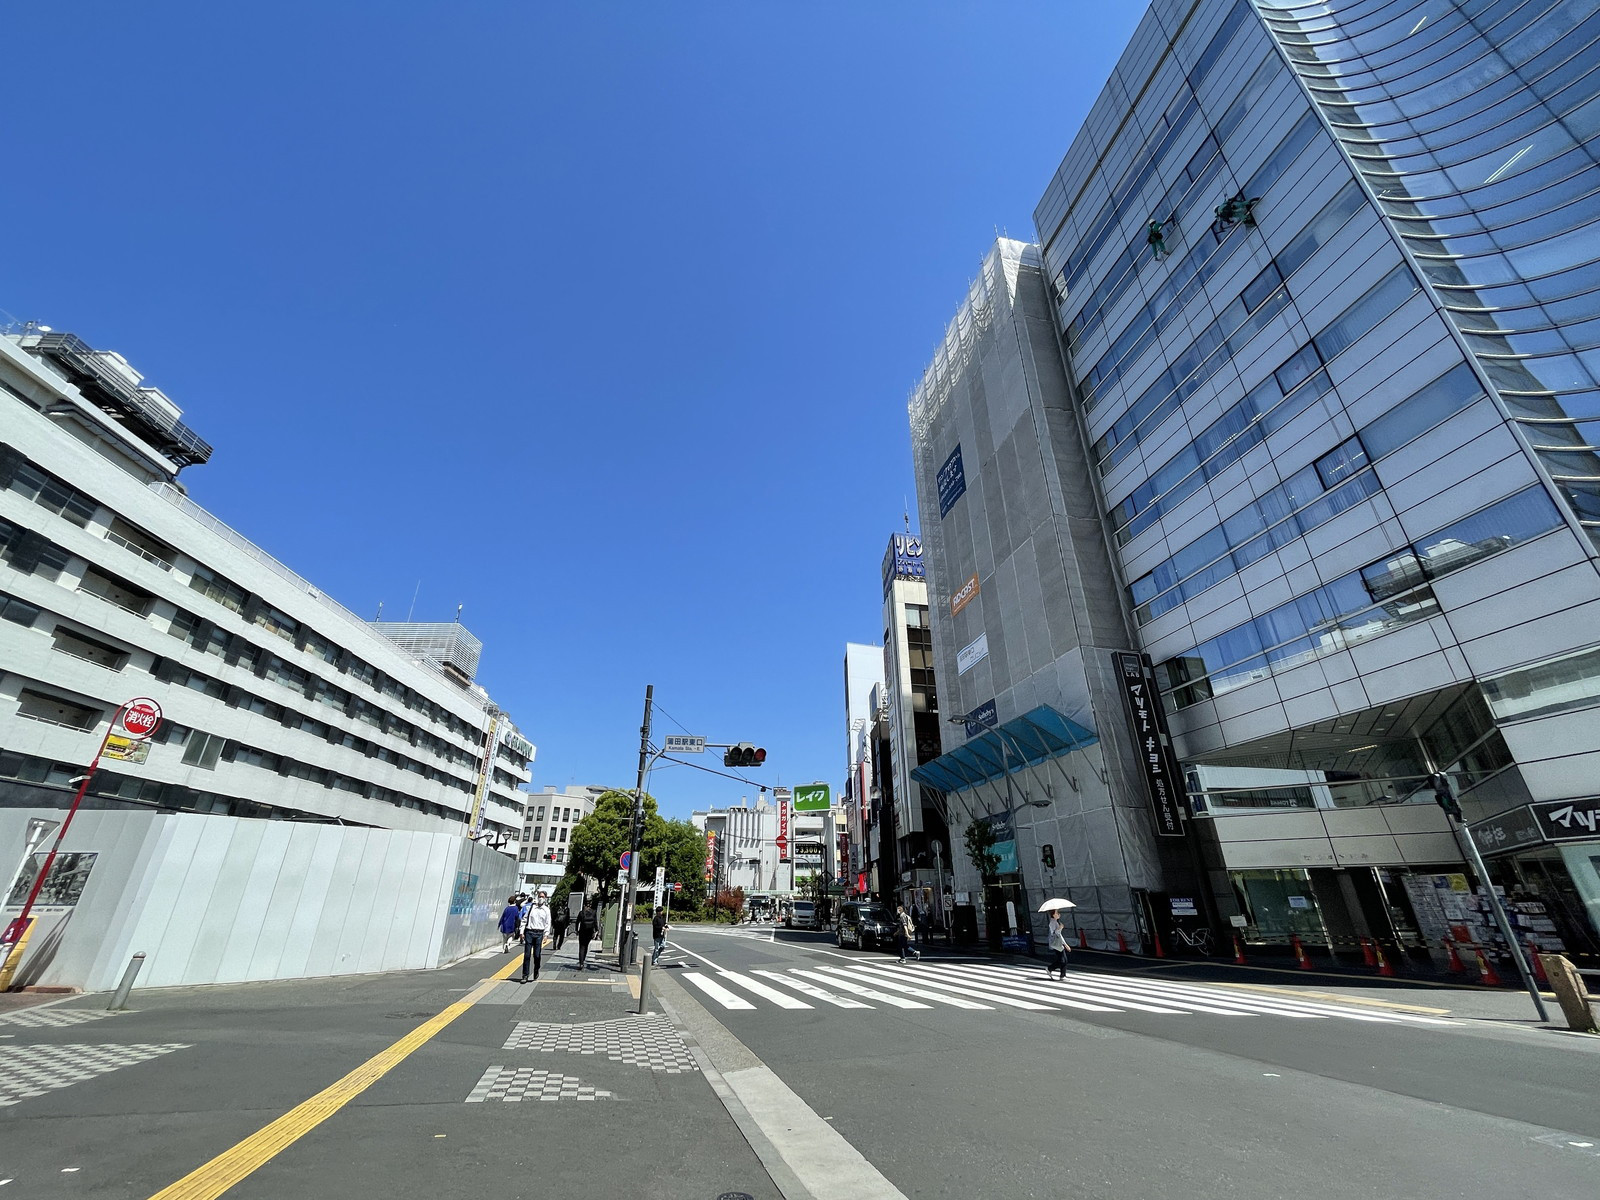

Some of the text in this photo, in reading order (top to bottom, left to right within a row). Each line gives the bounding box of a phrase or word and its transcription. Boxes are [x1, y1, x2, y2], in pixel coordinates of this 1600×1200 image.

[126, 710, 154, 728] 消火栓
[667, 737, 703, 746] 蒲田駅東口
[796, 790, 825, 803] レイク
